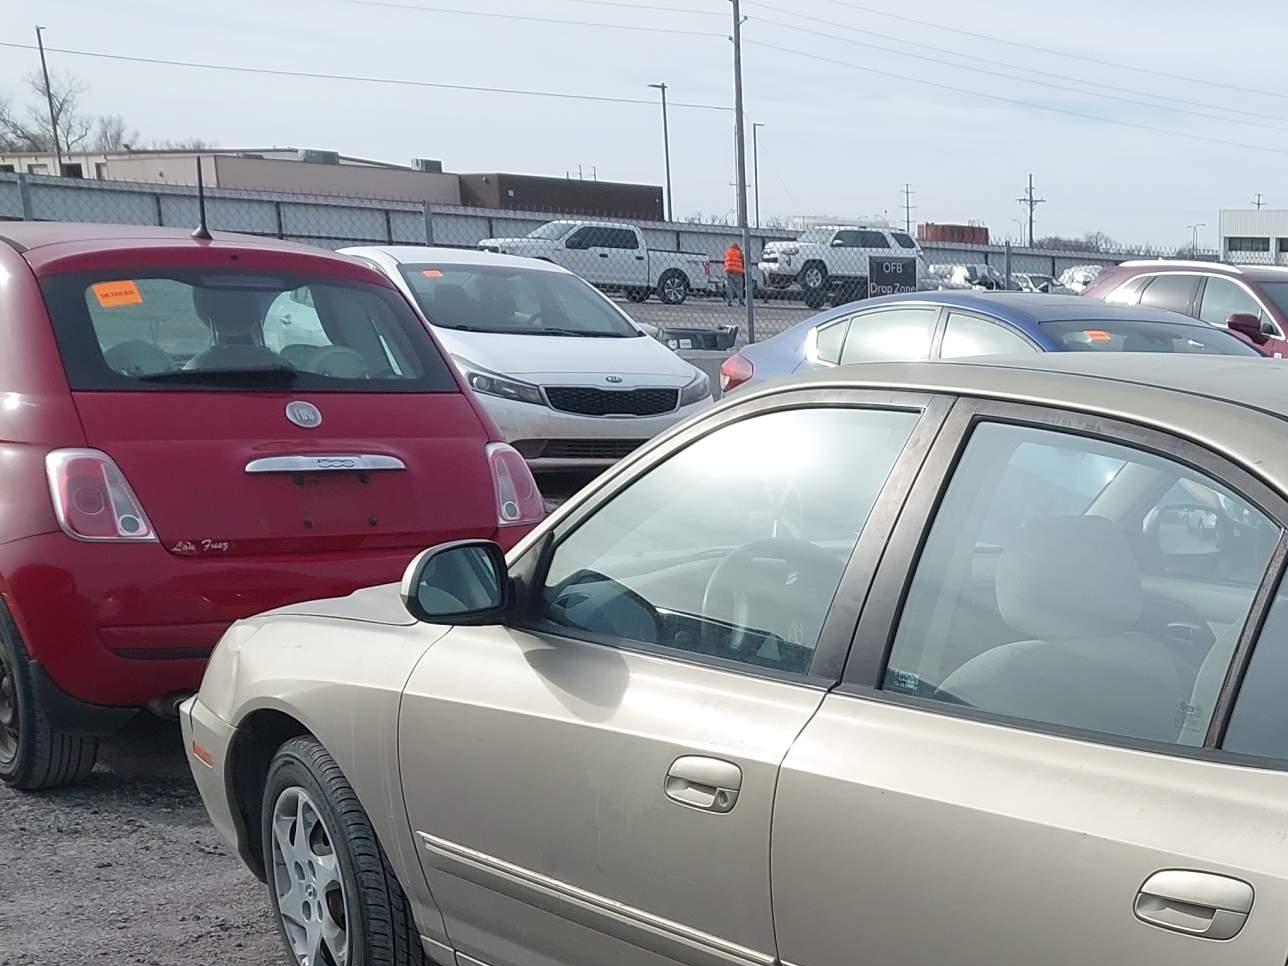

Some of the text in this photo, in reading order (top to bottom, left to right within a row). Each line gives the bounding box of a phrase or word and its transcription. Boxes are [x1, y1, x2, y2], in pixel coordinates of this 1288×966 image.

[870, 282, 916, 294] Drop Zone
[317, 458, 355, 468] 500
